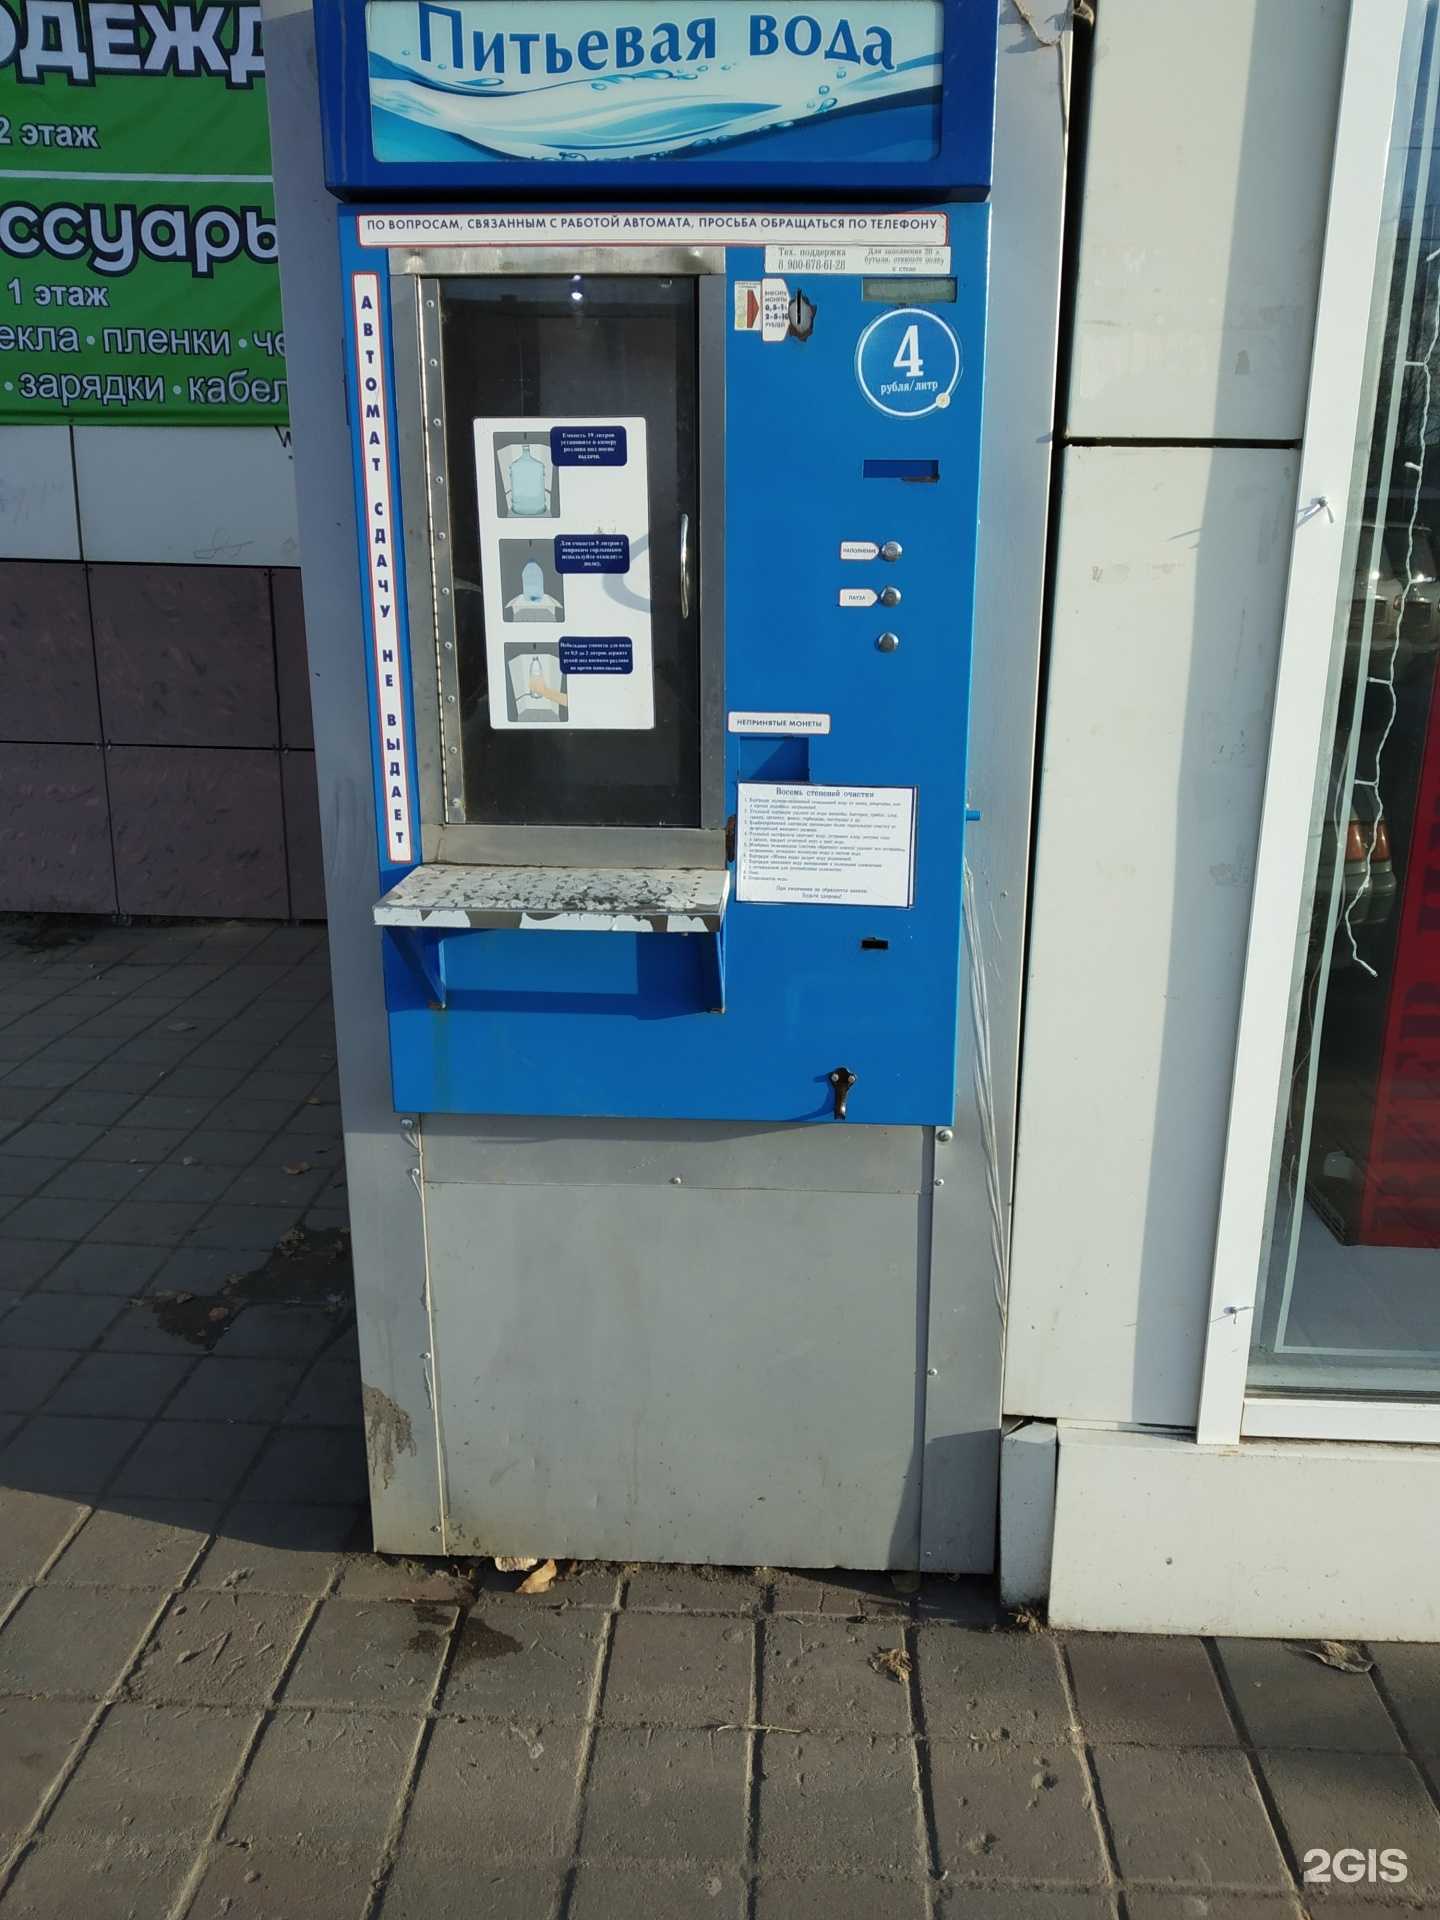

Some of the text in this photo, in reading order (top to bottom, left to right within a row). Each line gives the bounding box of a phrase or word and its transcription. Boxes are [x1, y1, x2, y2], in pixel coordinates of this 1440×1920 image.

[418, 1, 896, 75] Питьевая вода
[0, 117, 98, 147] 2 этаж
[367, 215, 938, 231] ПО ВОПРОСАМ, СВЯЗАННЫМ С РАБОТОЙ АВТОМАТА, ПРОСЬБА ОБРАЩАТЬСЯ ПО ТЕЛЕФОНУ
[799, 248, 847, 258] поддержка
[8, 279, 109, 308] 1 этаж
[103, 328, 230, 355] пленки
[893, 325, 925, 377] 4
[18, 372, 164, 406] зарядки
[880, 379, 939, 395] рубля/литр
[361, 295, 405, 844] АВТОМАТ СДАЧУ НЕ ВЫДАЕТ
[736, 719, 823, 728] НЕПРИНЯТЫЕ МОНЕТЫ
